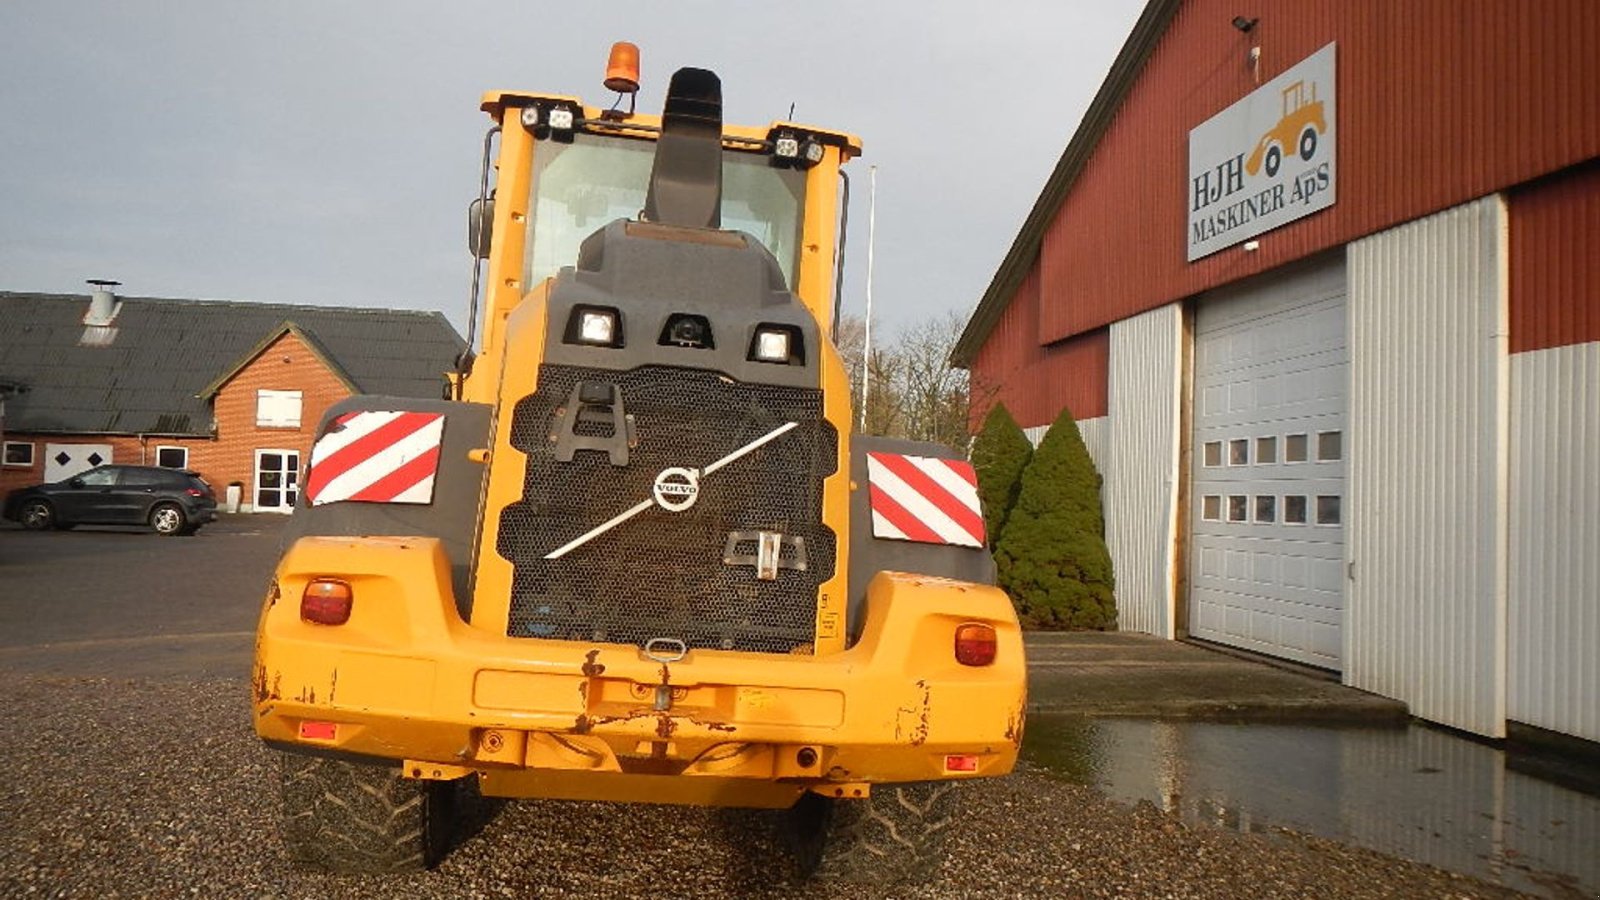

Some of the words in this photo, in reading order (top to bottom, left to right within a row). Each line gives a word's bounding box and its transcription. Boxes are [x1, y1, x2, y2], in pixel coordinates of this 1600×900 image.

[1192, 153, 1245, 212] HJH
[1192, 183, 1284, 245] MASKINER
[1290, 162, 1329, 205] ApS
[657, 484, 697, 494] VOLVO
